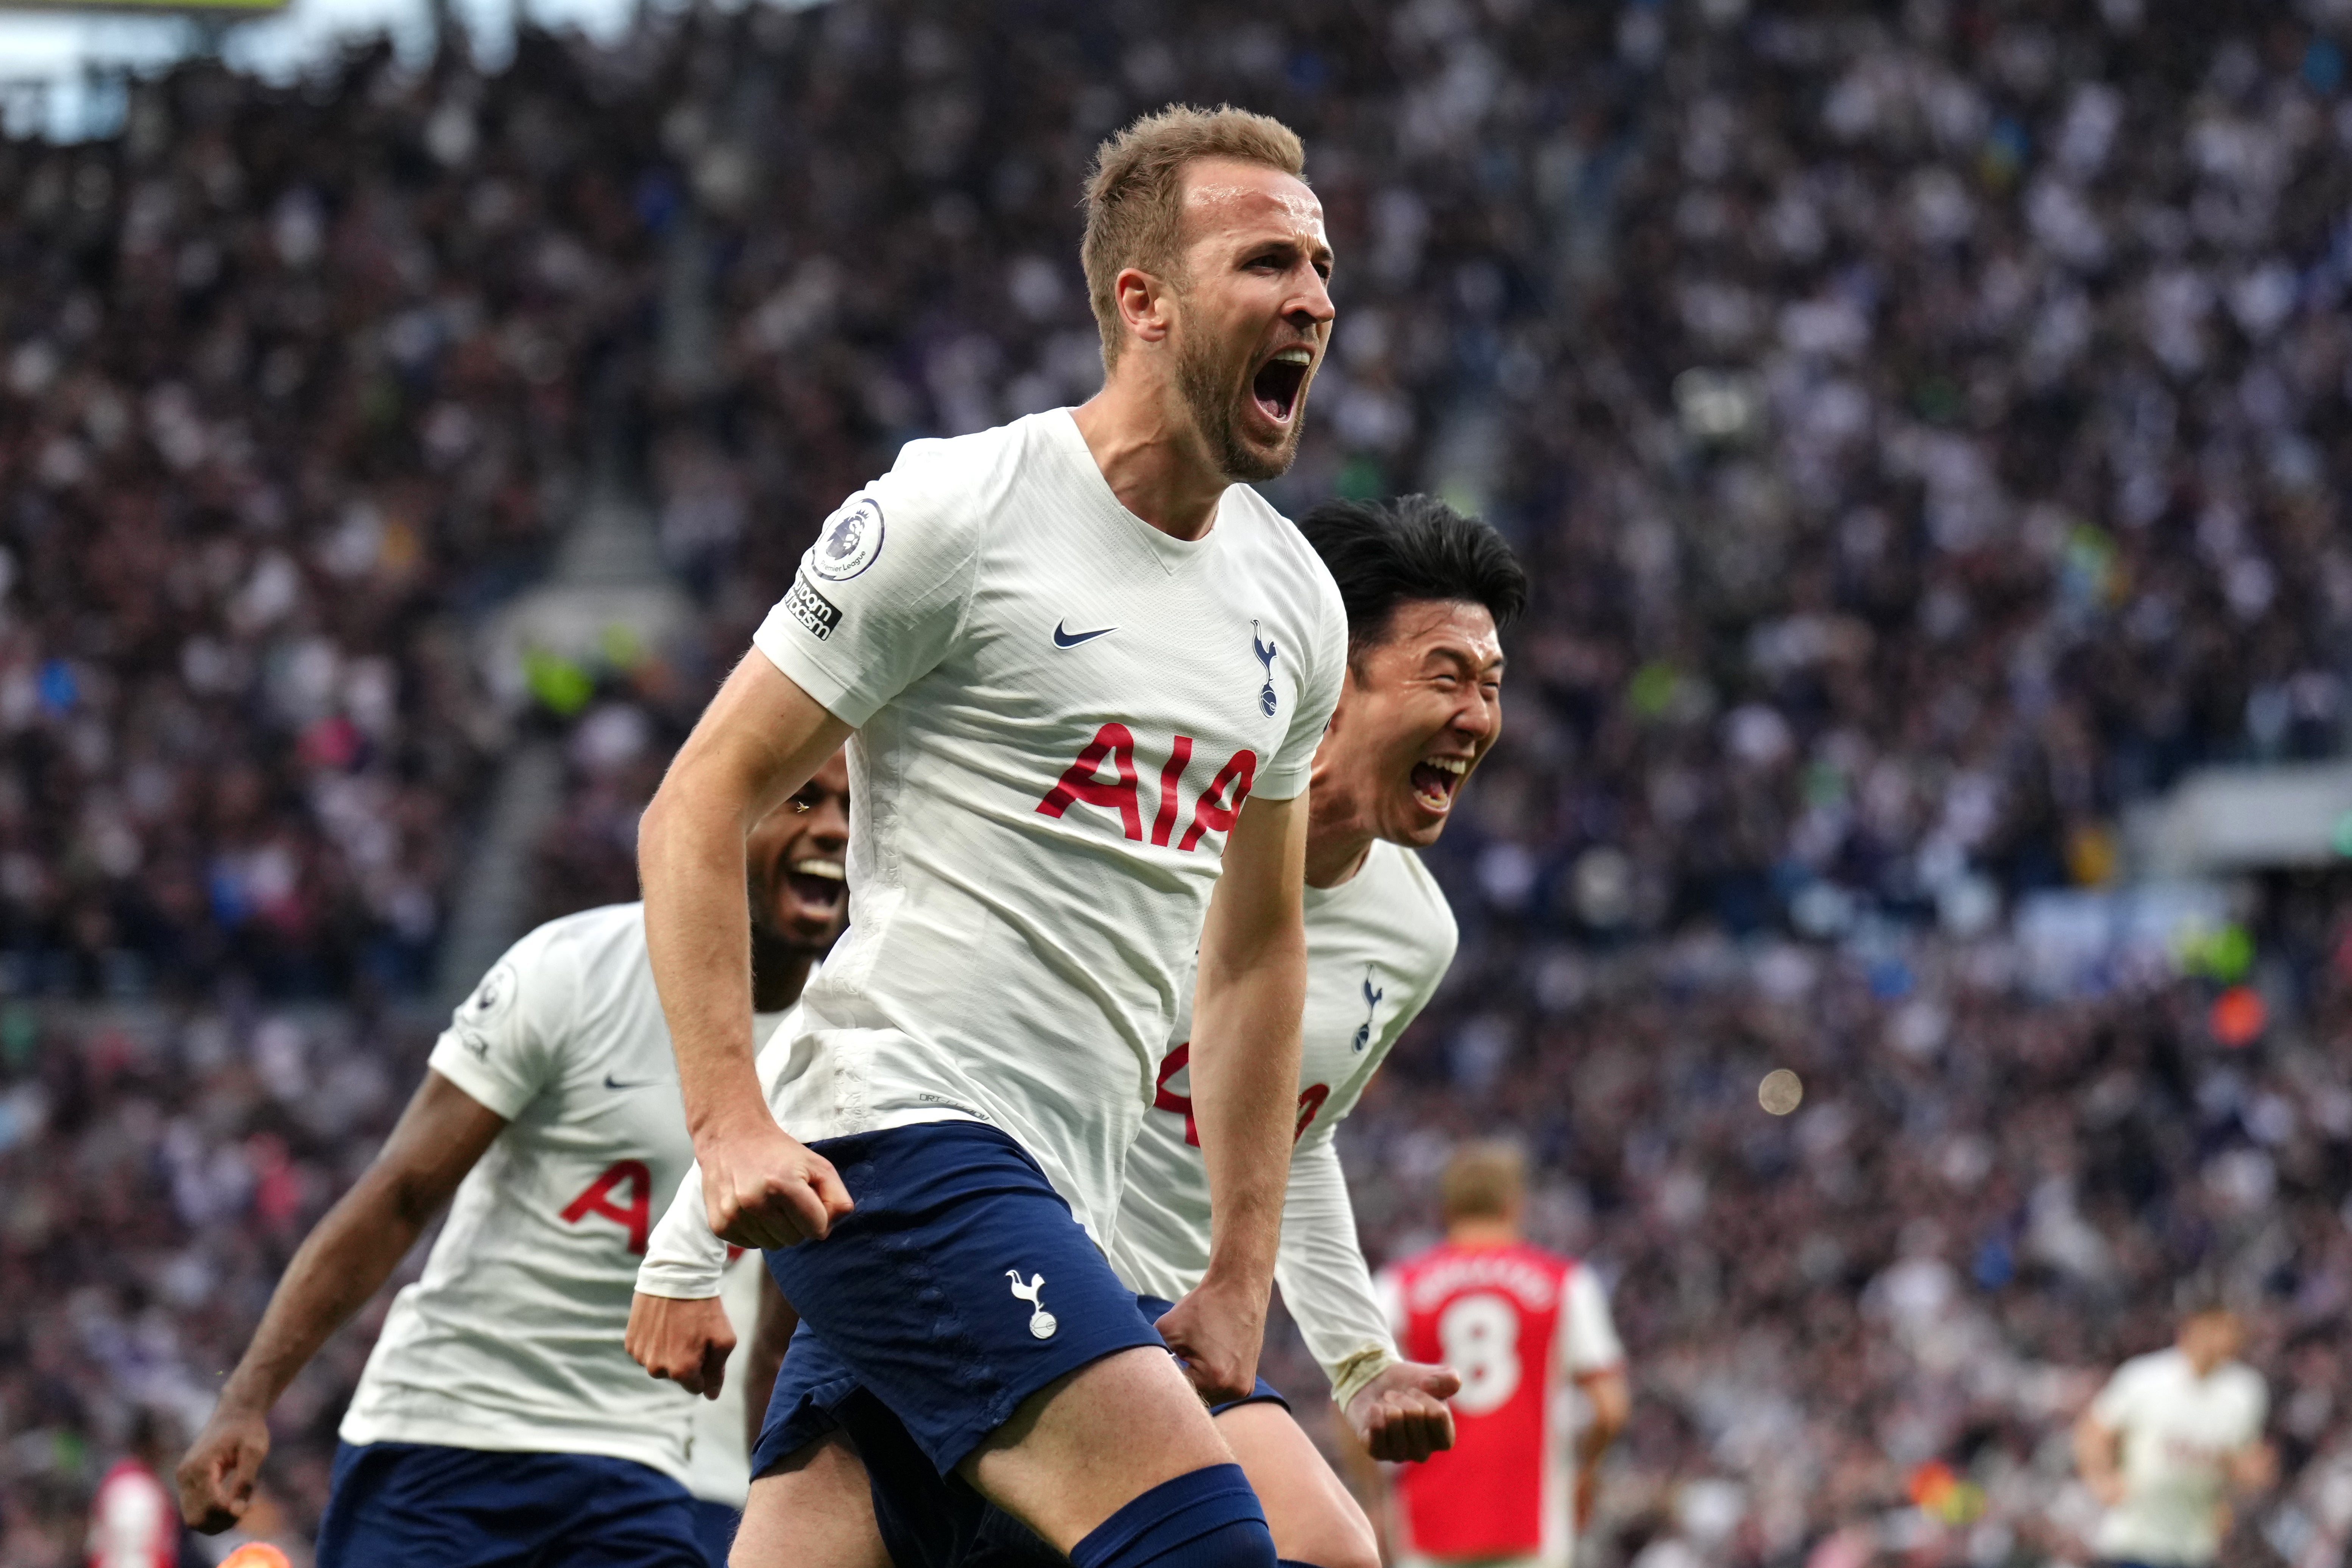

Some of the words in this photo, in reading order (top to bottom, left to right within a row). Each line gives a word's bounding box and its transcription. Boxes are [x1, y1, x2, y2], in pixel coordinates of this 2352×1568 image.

[820, 560, 842, 572] Premier
[842, 551, 866, 570] League
[786, 595, 831, 640] racism
[797, 583, 832, 622] room
[1035, 722, 1257, 857] AIA
[1437, 1292, 1522, 1417] 8
